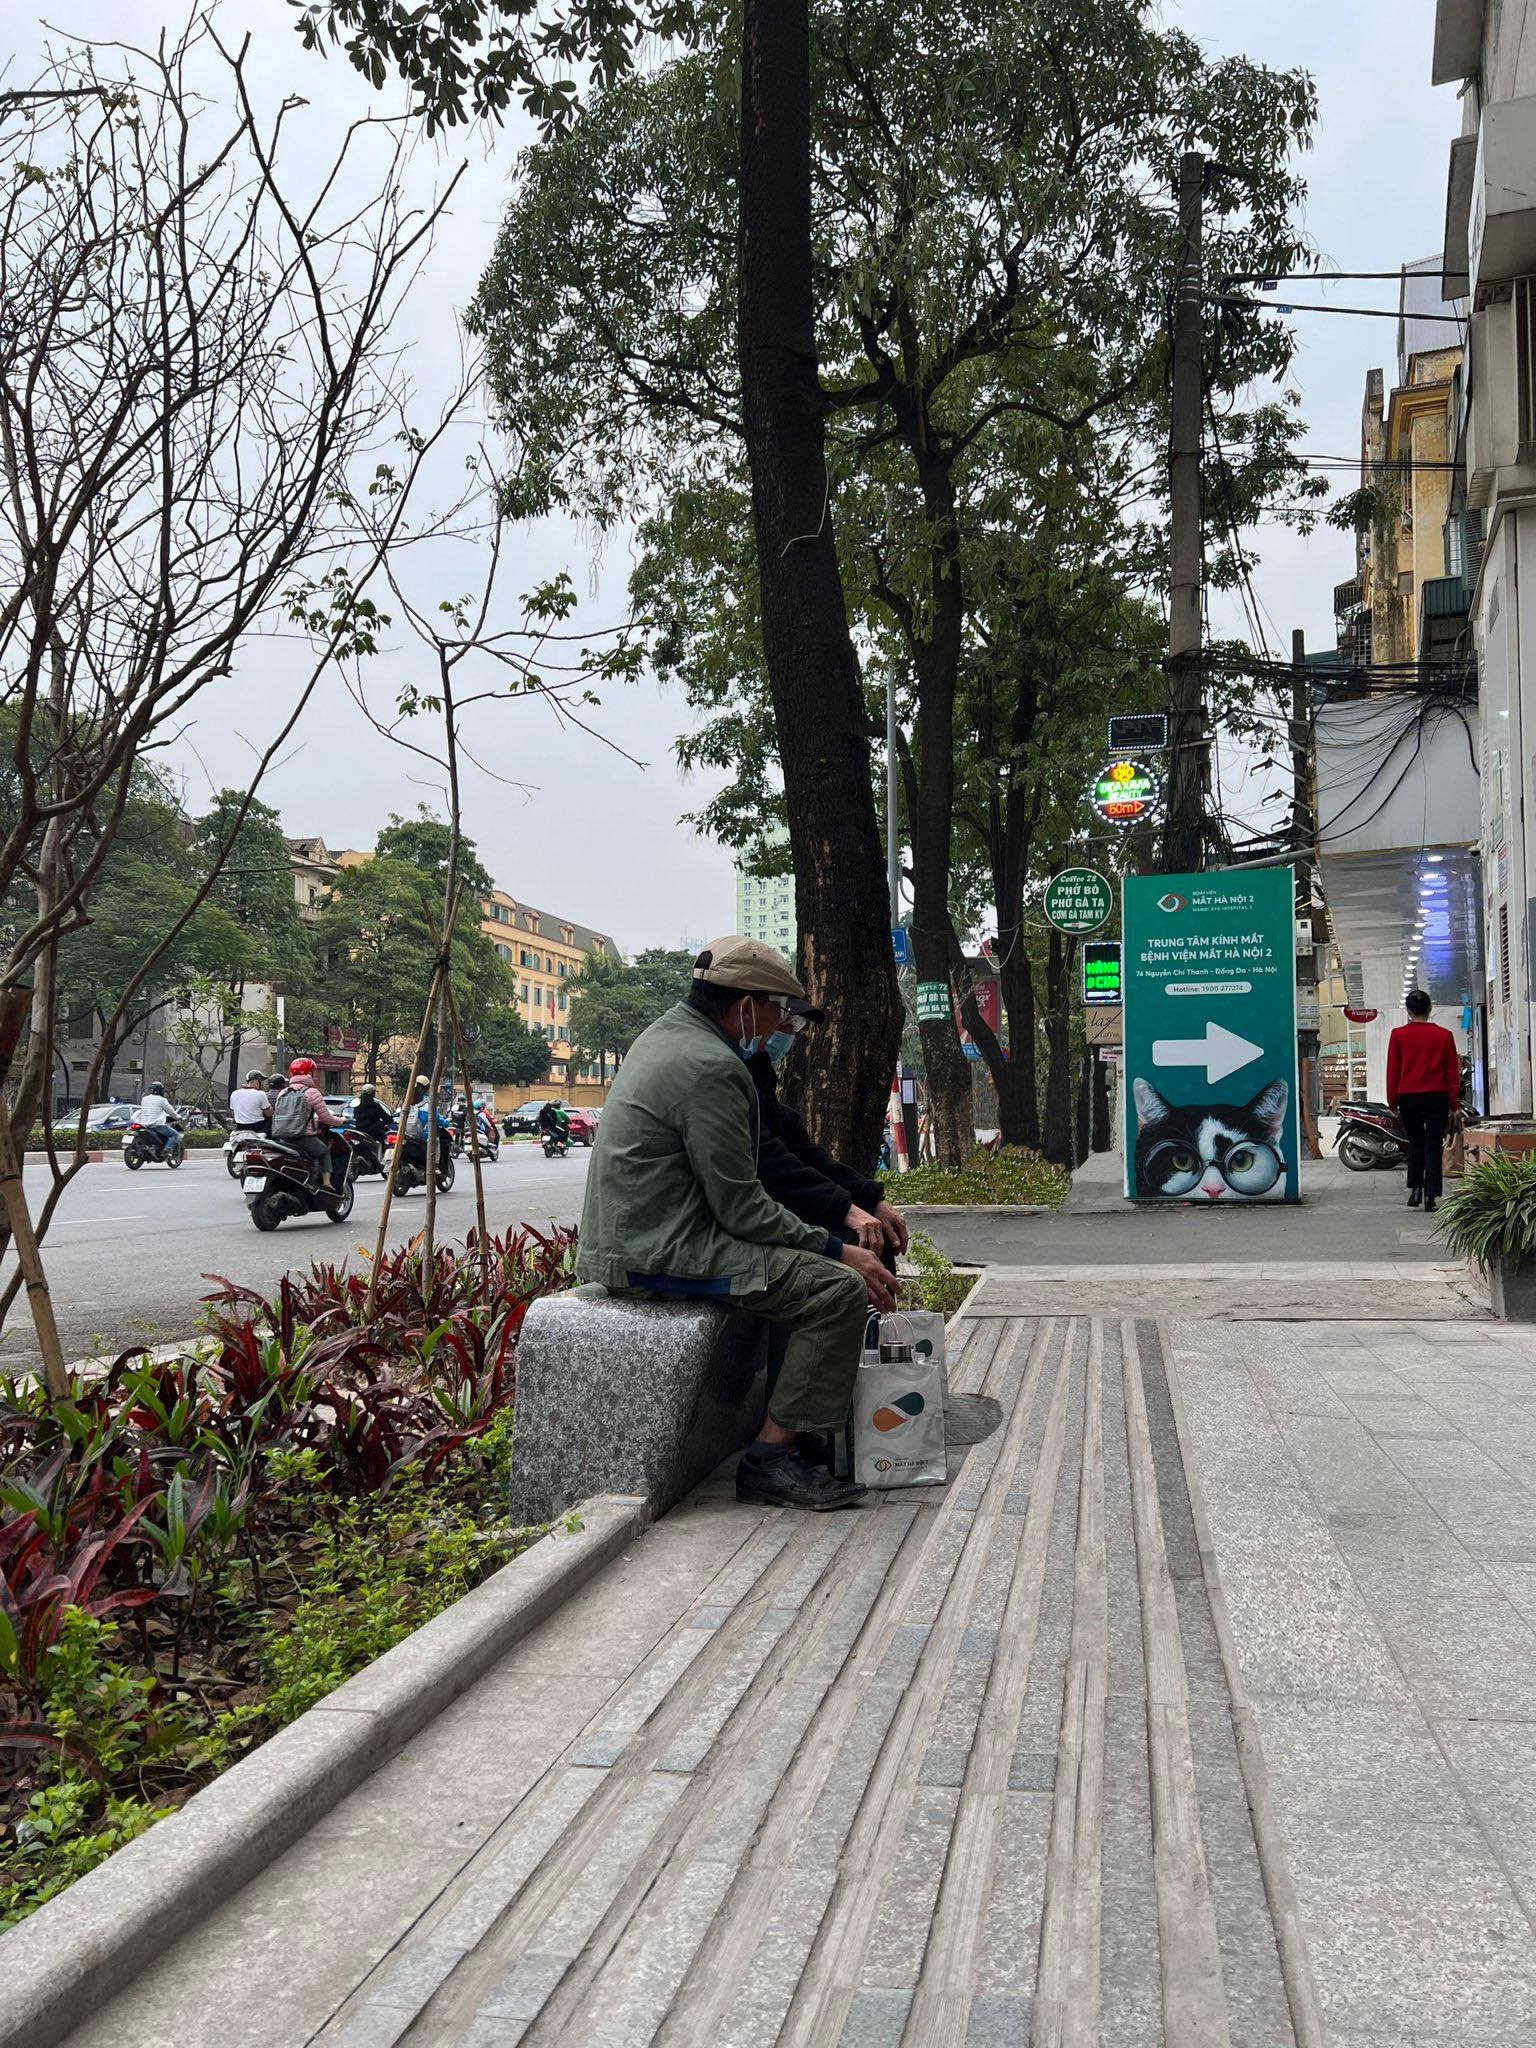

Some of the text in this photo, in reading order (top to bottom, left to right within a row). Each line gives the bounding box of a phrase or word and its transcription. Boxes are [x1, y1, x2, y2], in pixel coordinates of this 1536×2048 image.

[1060, 875, 1085, 883] Coffee
[1057, 883, 1100, 896] PHỞ BÒ
[1051, 895, 1105, 908] PHỞ GÀ TA
[1192, 893, 1254, 905] MẮT HÀ NỘI 2
[1052, 909, 1067, 920] CƠM
[1068, 908, 1078, 920] GÀ
[1079, 910, 1094, 920] TAM
[1147, 932, 1264, 948] TRUNG TÂM KÍNH MẮT
[1140, 946, 1272, 964] BỆNH VIỆN MẮT HÀ NỘI 2
[1145, 968, 1171, 978] Nguyễn
[1187, 968, 1209, 976] Thanh
[1215, 967, 1234, 976] Đống
[1265, 965, 1277, 974] Nội
